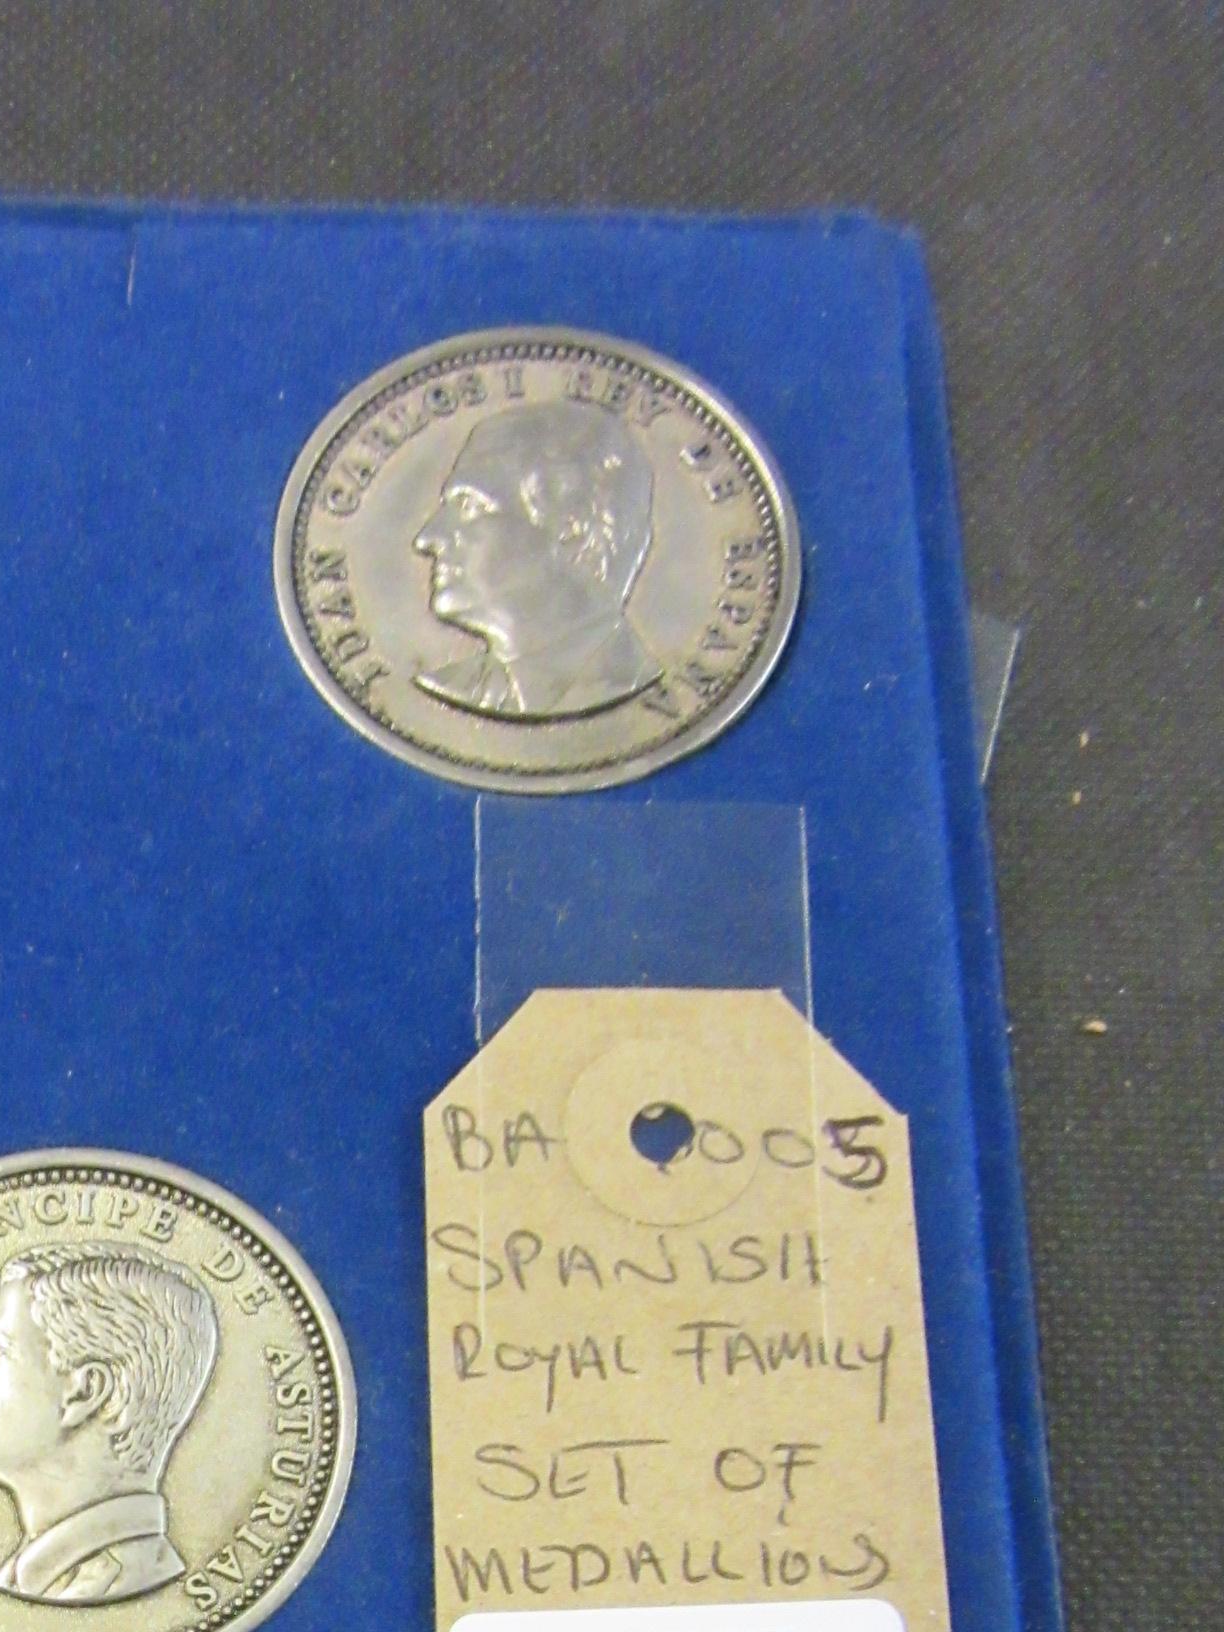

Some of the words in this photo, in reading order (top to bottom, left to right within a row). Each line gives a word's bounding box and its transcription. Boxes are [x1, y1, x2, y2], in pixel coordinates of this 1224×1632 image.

[565, 366, 672, 428] REY
[322, 373, 487, 517] CARLOS
[679, 440, 744, 505] DE
[309, 548, 390, 688] JUAN
[441, 1103, 565, 1172] BA
[201, 1242, 276, 1316] DE
[431, 1222, 831, 1292] SPANISH
[452, 1321, 640, 1414] ROYAL
[674, 1321, 894, 1423] FAMILY
[182, 1343, 316, 1612] ASTURIAS
[475, 1439, 670, 1506] SET
[714, 1444, 824, 1502] OF
